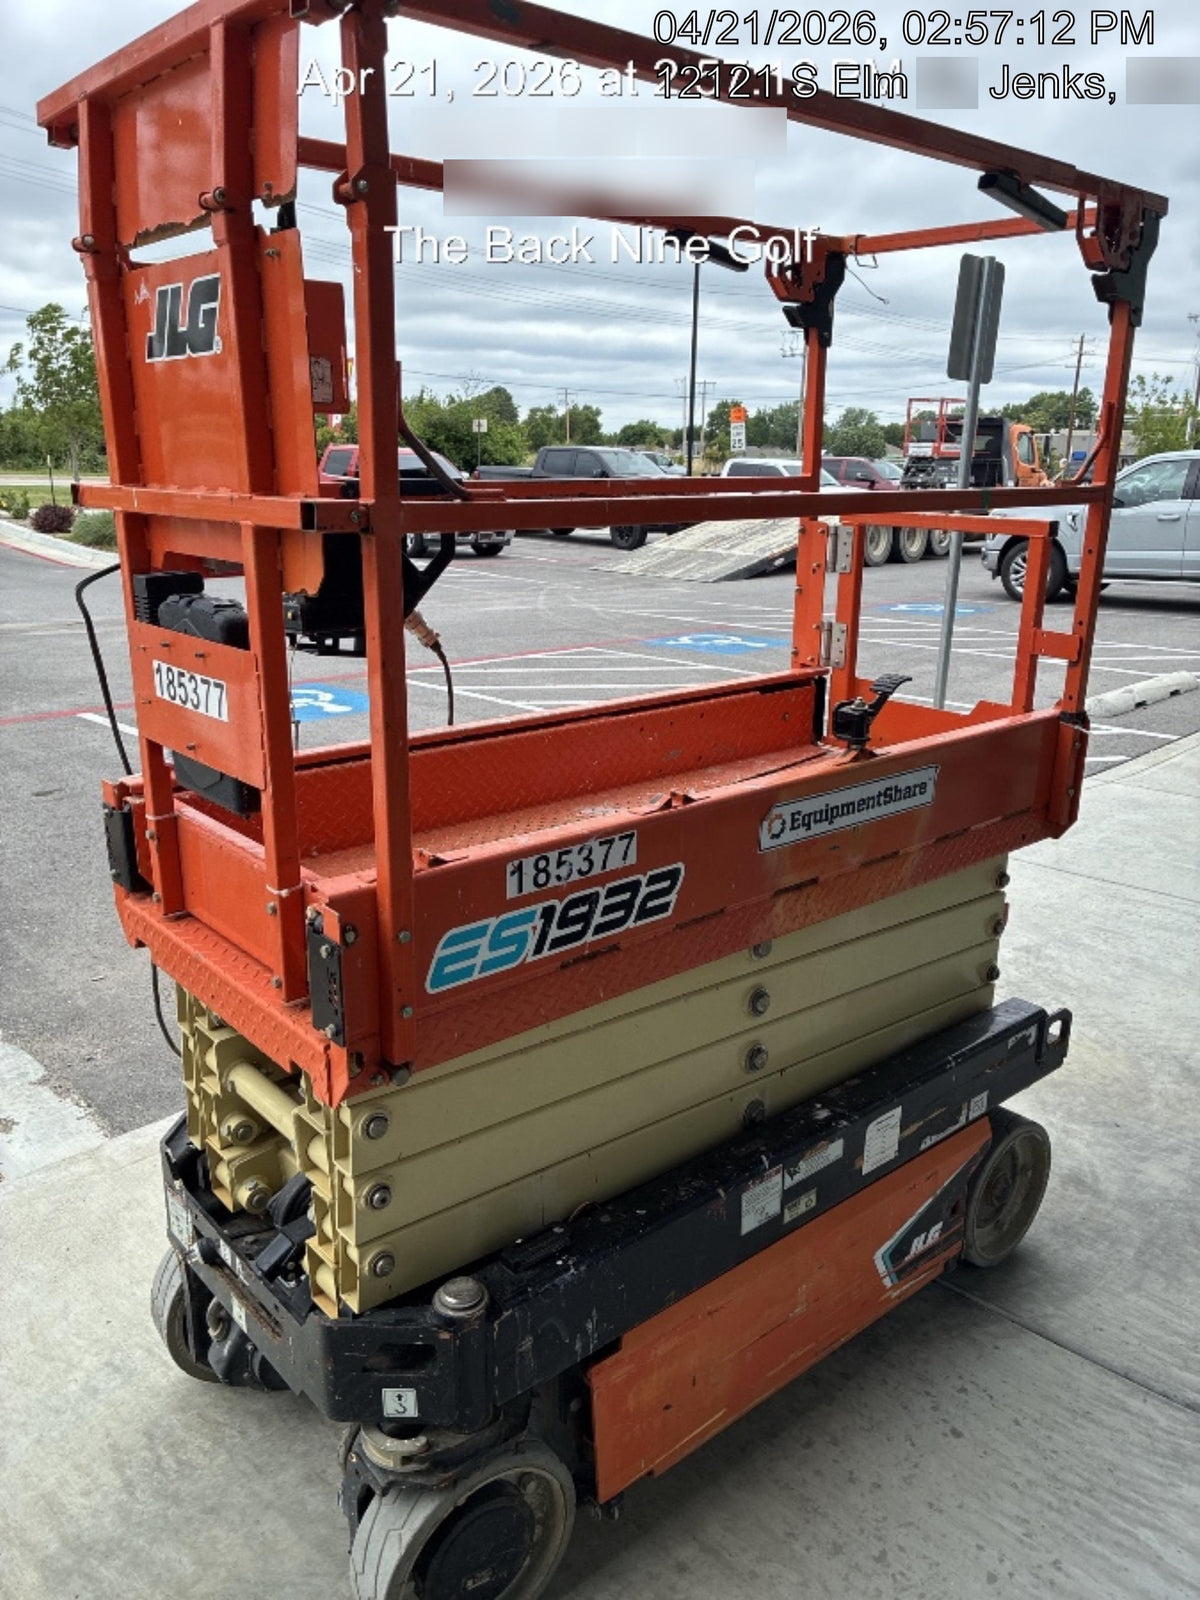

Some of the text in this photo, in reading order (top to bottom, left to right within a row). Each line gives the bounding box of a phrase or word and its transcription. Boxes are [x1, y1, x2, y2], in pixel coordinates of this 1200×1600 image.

[145, 272, 221, 362] JLG
[154, 662, 226, 719] 185377
[789, 780, 928, 832] EquipmentShare
[508, 833, 636, 894] 185377
[426, 863, 684, 994] ES1932
